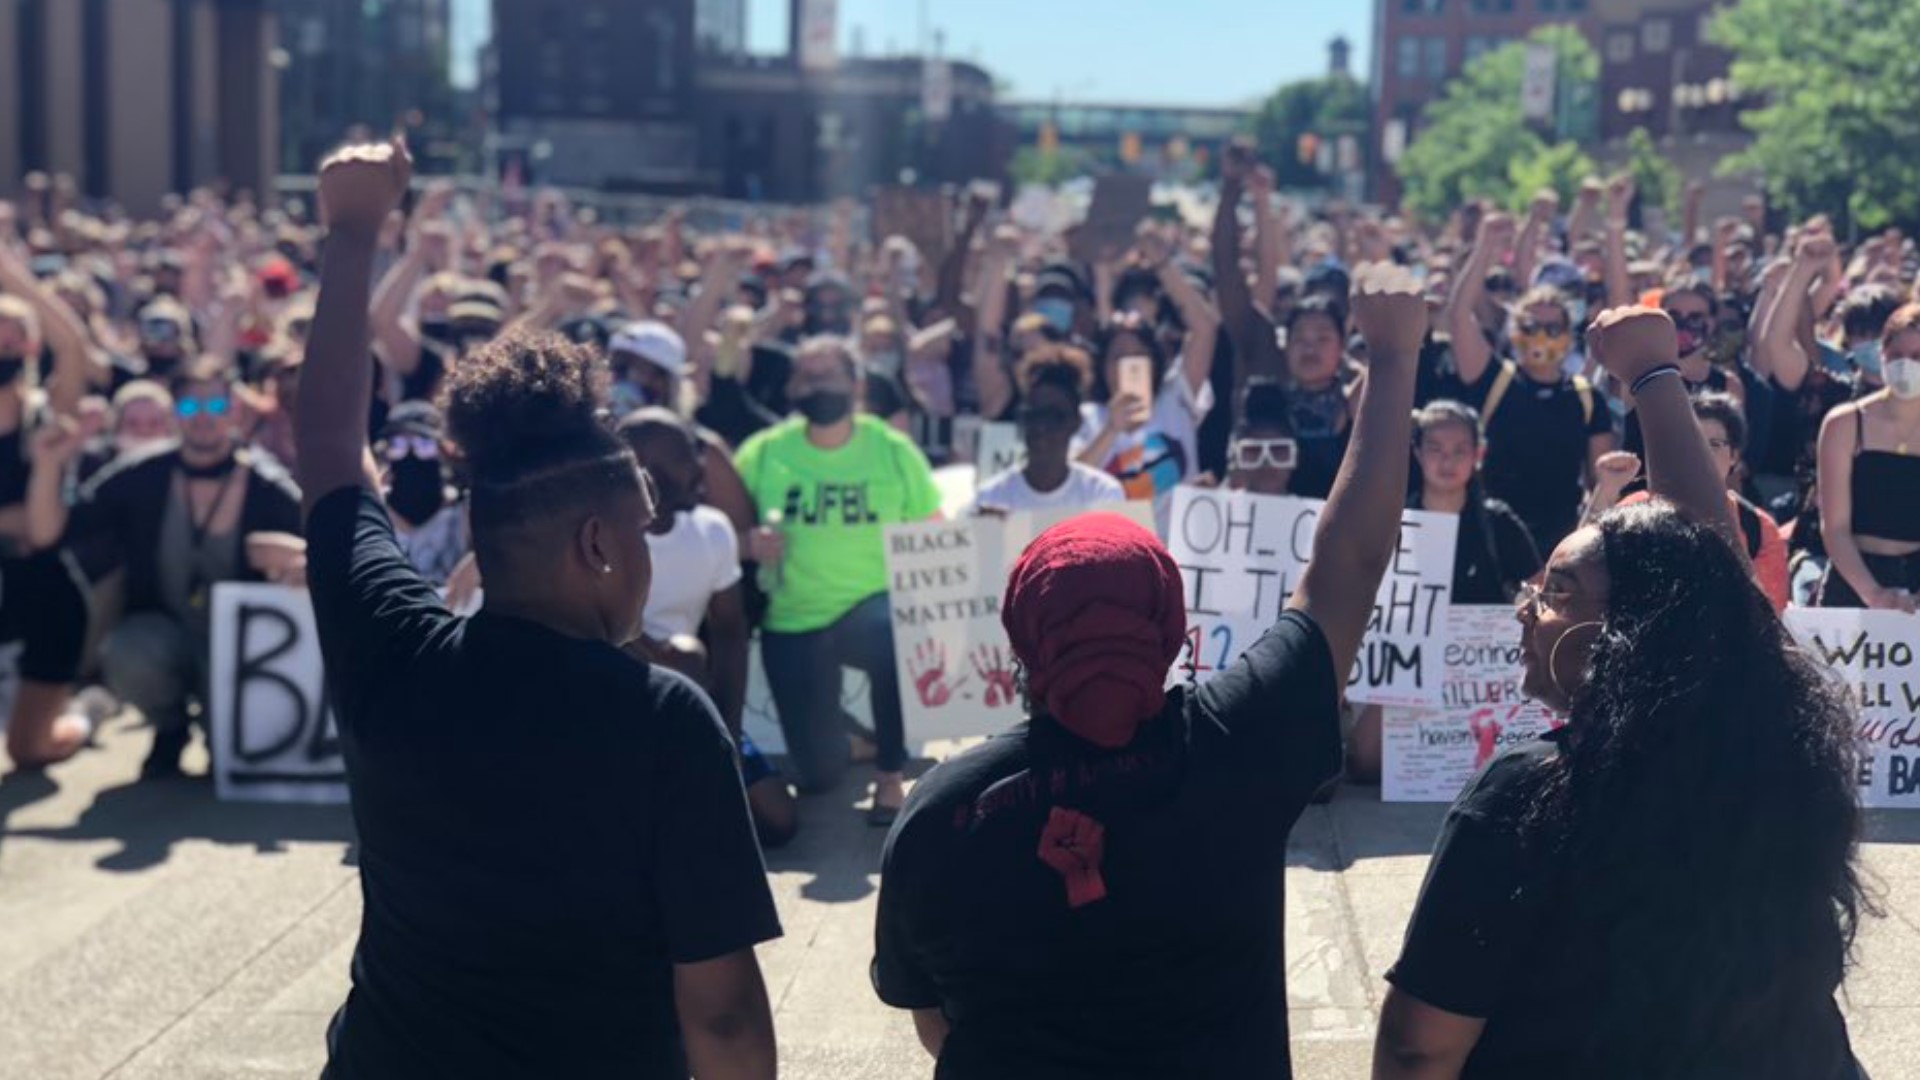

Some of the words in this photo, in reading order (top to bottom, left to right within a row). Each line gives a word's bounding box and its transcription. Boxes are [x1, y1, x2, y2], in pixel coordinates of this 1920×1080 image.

[890, 528, 972, 554] BLACK
[894, 565, 969, 592] LIVES
[1178, 564, 1223, 616] I
[894, 596, 1001, 625] MATTER
[1444, 643, 1523, 667] eonna
[1813, 631, 1913, 669] WHO
